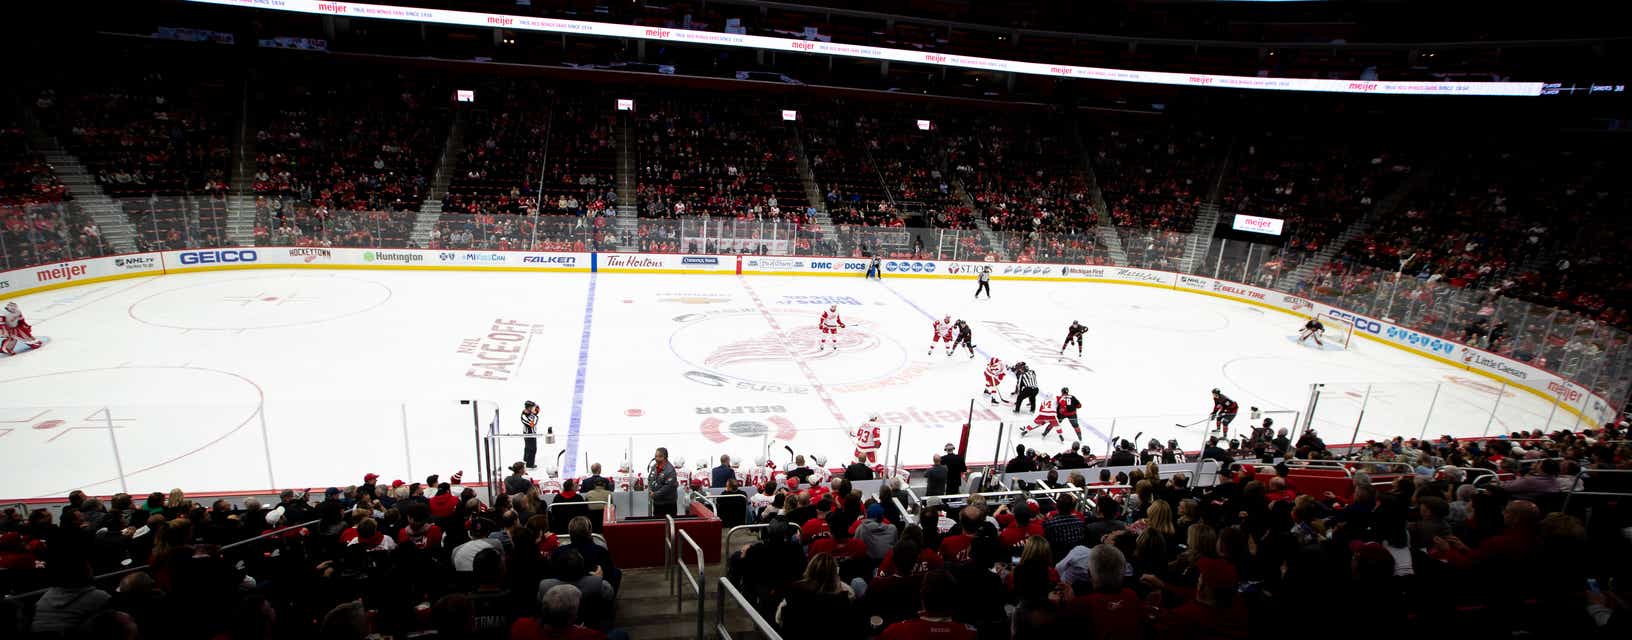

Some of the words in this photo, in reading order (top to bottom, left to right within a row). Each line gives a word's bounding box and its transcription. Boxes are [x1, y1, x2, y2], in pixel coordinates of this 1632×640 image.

[318, 2, 347, 13] meijer
[487, 16, 513, 26] meijer
[645, 28, 670, 39] meijer
[792, 41, 814, 51] meijer
[925, 54, 946, 63] meijer
[1050, 66, 1072, 75] meijer
[1189, 75, 1213, 85] meijer
[1348, 81, 1378, 92] meijer
[1245, 218, 1272, 228] meijer
[180, 250, 258, 265] GEICO
[289, 249, 331, 260] HOCKEYTOWN
[376, 252, 423, 263] Huntington
[523, 256, 576, 265] FALKEN
[607, 256, 625, 266] Tim
[626, 256, 664, 268] Hortons
[811, 262, 832, 270] DMC
[844, 263, 866, 272] DOCS
[37, 264, 88, 282] meijer
[1221, 285, 1246, 296] BELLE
[1248, 289, 1266, 300] TIRE
[1497, 361, 1528, 379] Caesars
[695, 405, 788, 415] BELFOR
[857, 428, 870, 443] 93
